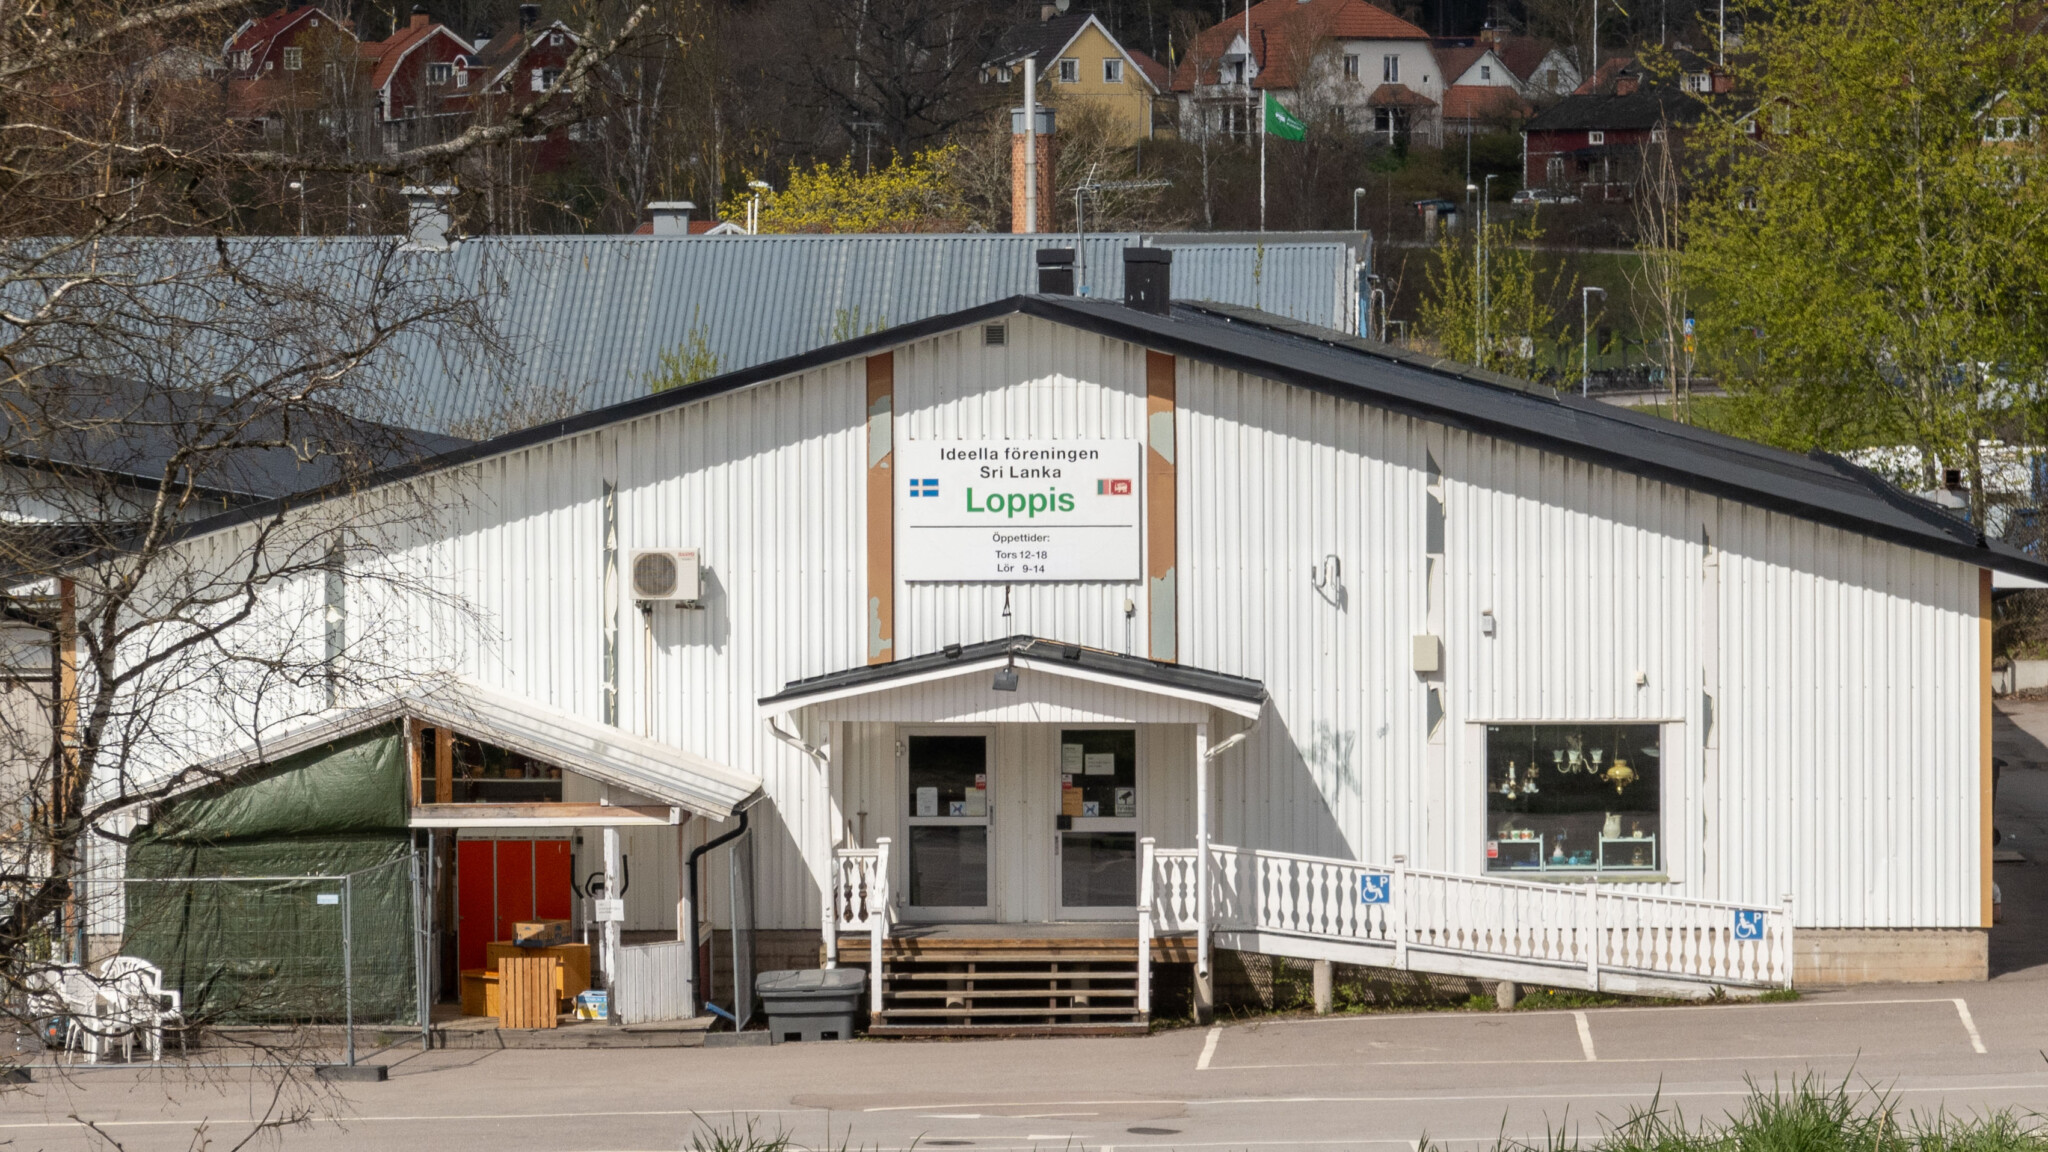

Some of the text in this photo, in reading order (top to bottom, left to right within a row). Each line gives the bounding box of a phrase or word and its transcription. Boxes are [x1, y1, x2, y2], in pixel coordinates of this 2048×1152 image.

[940, 447, 1099, 463] Ideella föreningen
[979, 465, 1062, 479] Sri Lanka
[966, 486, 1075, 518] Loppis
[992, 532, 1051, 544] Öppettider:
[995, 549, 1048, 560] Tors 12-18
[997, 563, 1045, 574] Lör 9-14
[1380, 876, 1389, 888] P
[1753, 912, 1762, 924] P
